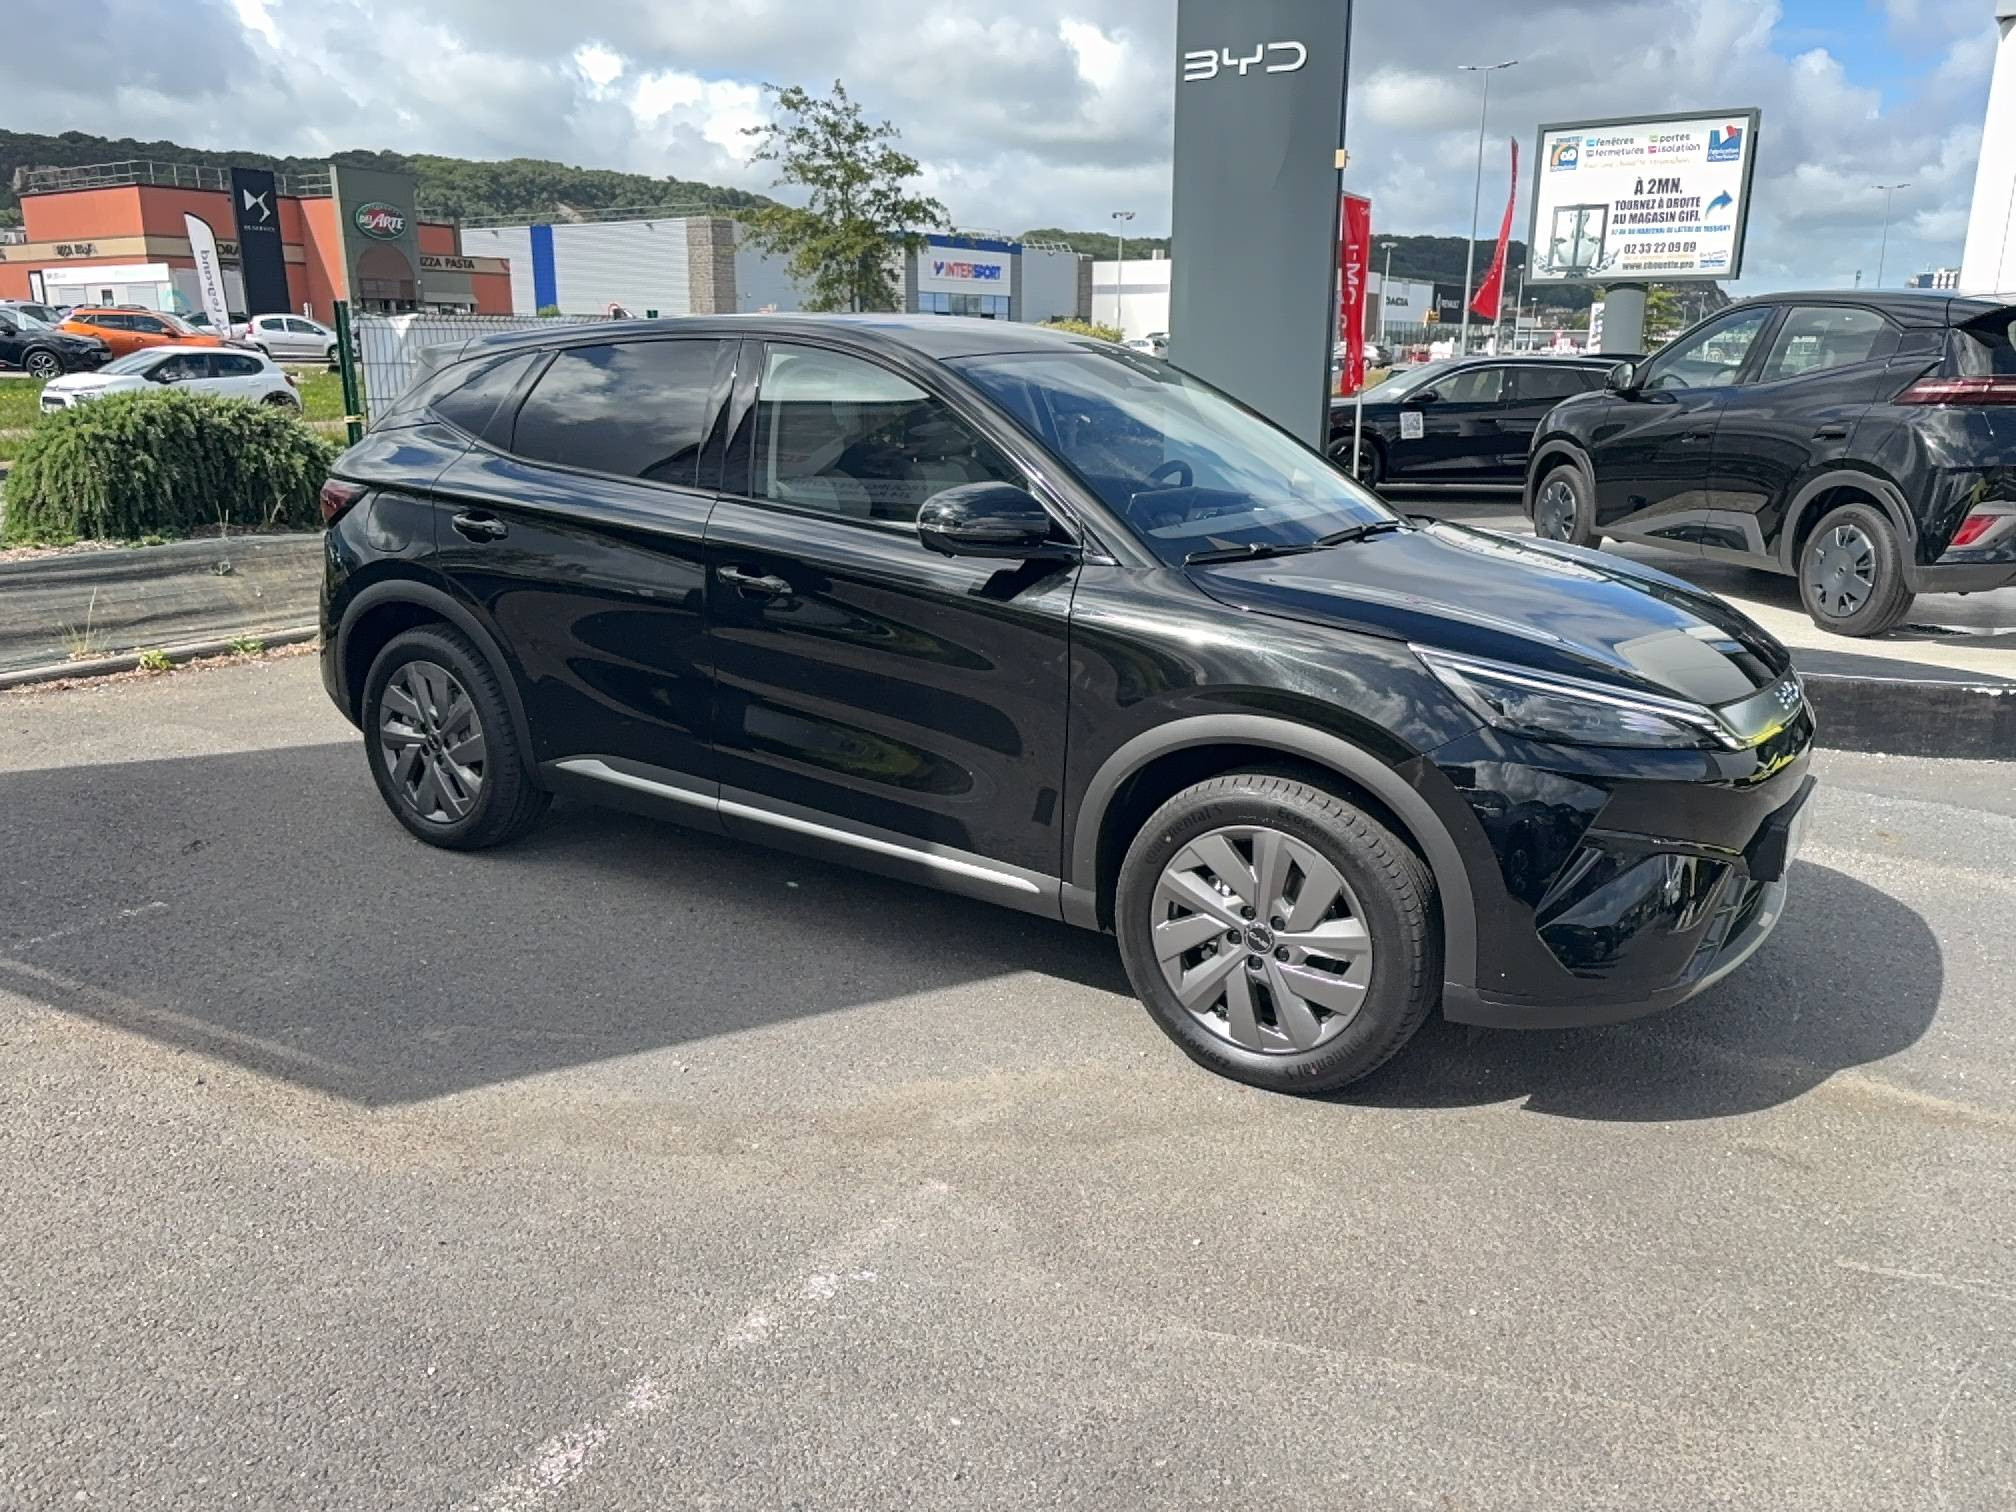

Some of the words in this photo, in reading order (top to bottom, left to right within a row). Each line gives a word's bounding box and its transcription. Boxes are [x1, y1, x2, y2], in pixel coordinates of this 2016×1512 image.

[1184, 41, 1307, 81] BYD
[1596, 137, 1634, 147] fenêtres
[1659, 133, 1690, 143] portes
[1595, 147, 1644, 157] fermetures
[1657, 143, 1701, 153] isolation
[1634, 176, 1643, 195] À
[1646, 177, 1683, 195] 2MN.
[1615, 199, 1656, 211] TOURNEZ
[1657, 196, 1664, 209] À
[1665, 196, 1701, 209] DROITE
[364, 212, 405, 234] ARTE
[1612, 213, 1626, 225] AU
[1628, 210, 1676, 224] MAGASIN
[1624, 243, 1637, 254] 02
[1638, 243, 1652, 254] 33
[1653, 242, 1666, 253] 22
[1668, 242, 1681, 253] 09
[419, 256, 442, 268] IZZA
[445, 258, 475, 269] PASTA
[944, 262, 1001, 280] INTERSPORT
